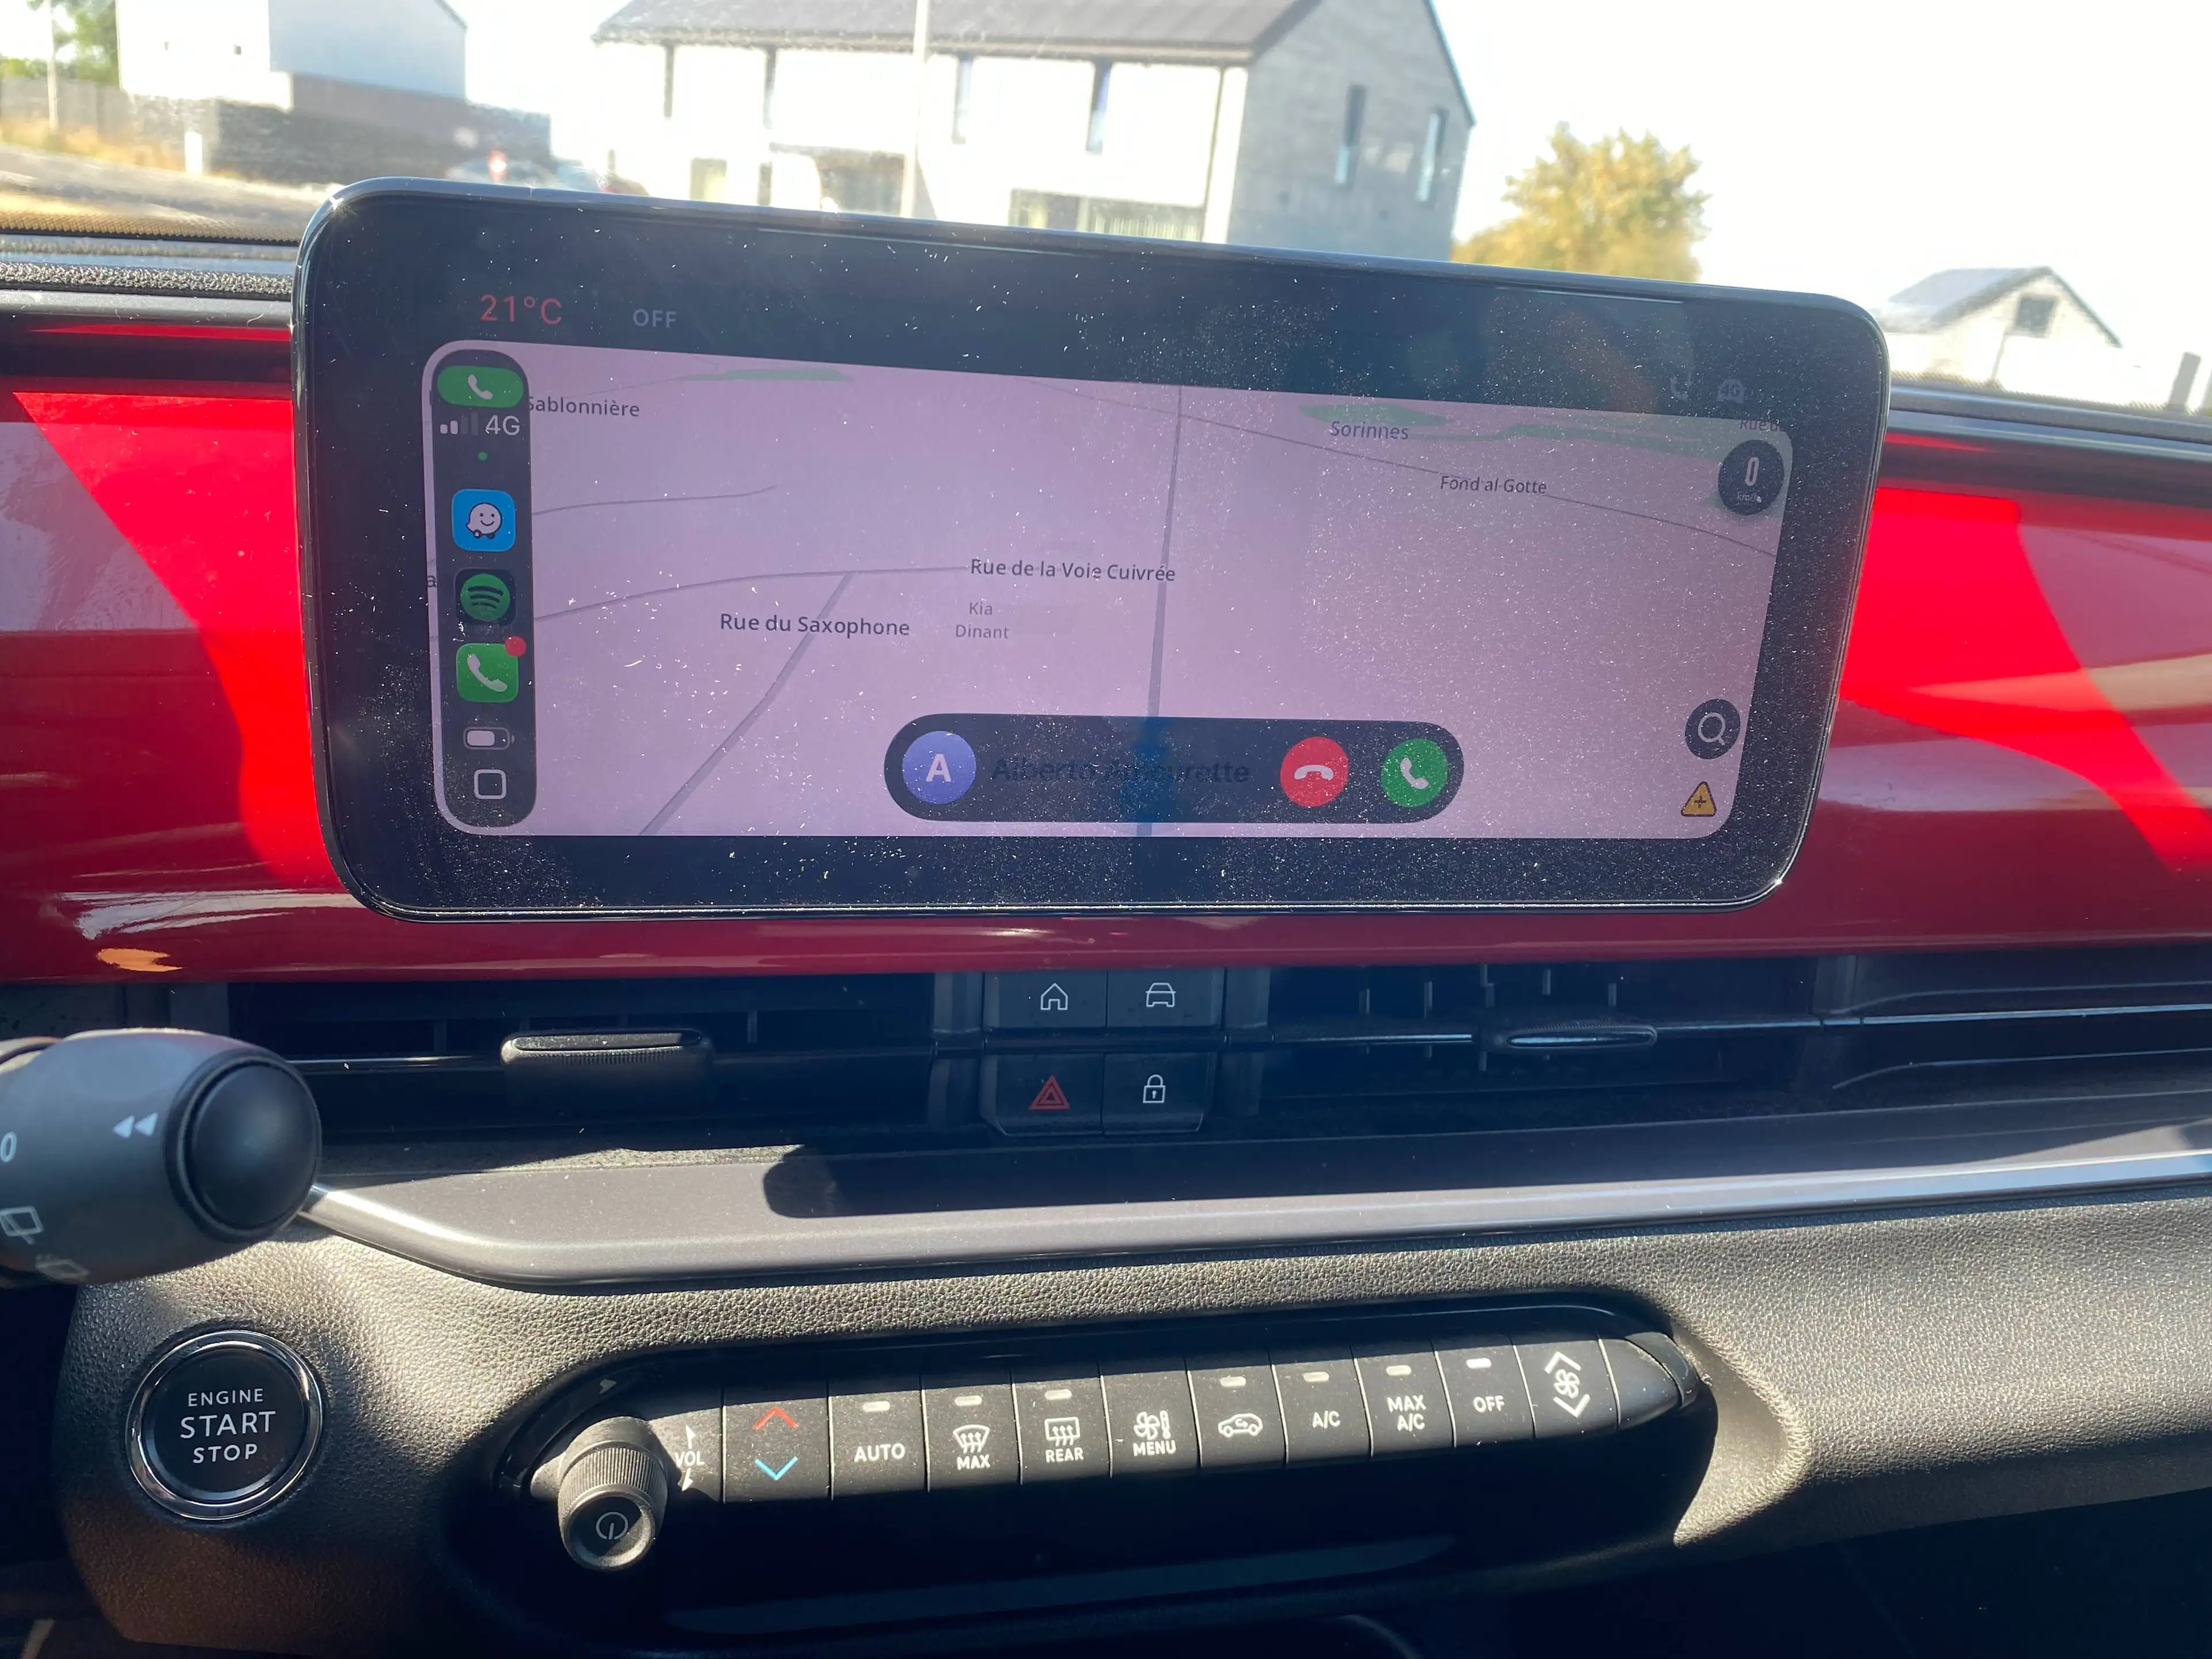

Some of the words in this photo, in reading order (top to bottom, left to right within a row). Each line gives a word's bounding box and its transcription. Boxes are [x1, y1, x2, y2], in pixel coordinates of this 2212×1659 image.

[479, 294, 562, 325] 21°C
[633, 309, 677, 328] OFF
[485, 414, 520, 435] 4G
[1330, 421, 1410, 440] Sorinnes
[1745, 457, 1760, 486] 0
[1440, 475, 1481, 492] Fond
[1484, 478, 1498, 492] al
[1503, 478, 1547, 494] Gotte
[971, 559, 1006, 575] Rue
[1012, 560, 1034, 576] de
[1040, 560, 1056, 577] la
[1062, 562, 1101, 579] Voie
[1107, 564, 1175, 581] Cuivrée
[969, 601, 993, 616] Kia
[721, 613, 760, 630] Rue
[766, 614, 791, 632] du
[798, 616, 910, 639] Saxophone
[956, 624, 1009, 639] Dinant
[926, 753, 952, 782] A
[992, 757, 1096, 782] Alberto
[187, 1388, 264, 1407] ENGINE
[1387, 1394, 1427, 1412] MAX
[1472, 1395, 1505, 1413] OFF
[180, 1411, 276, 1439] START
[1312, 1410, 1341, 1429] A/C
[1396, 1413, 1426, 1433] A/C
[192, 1443, 258, 1464] STOP
[854, 1443, 906, 1463] AUTO
[1046, 1447, 1084, 1463] REAR
[1133, 1440, 1176, 1456] MENU
[675, 1450, 706, 1467] VOL
[956, 1454, 991, 1470] MAX
